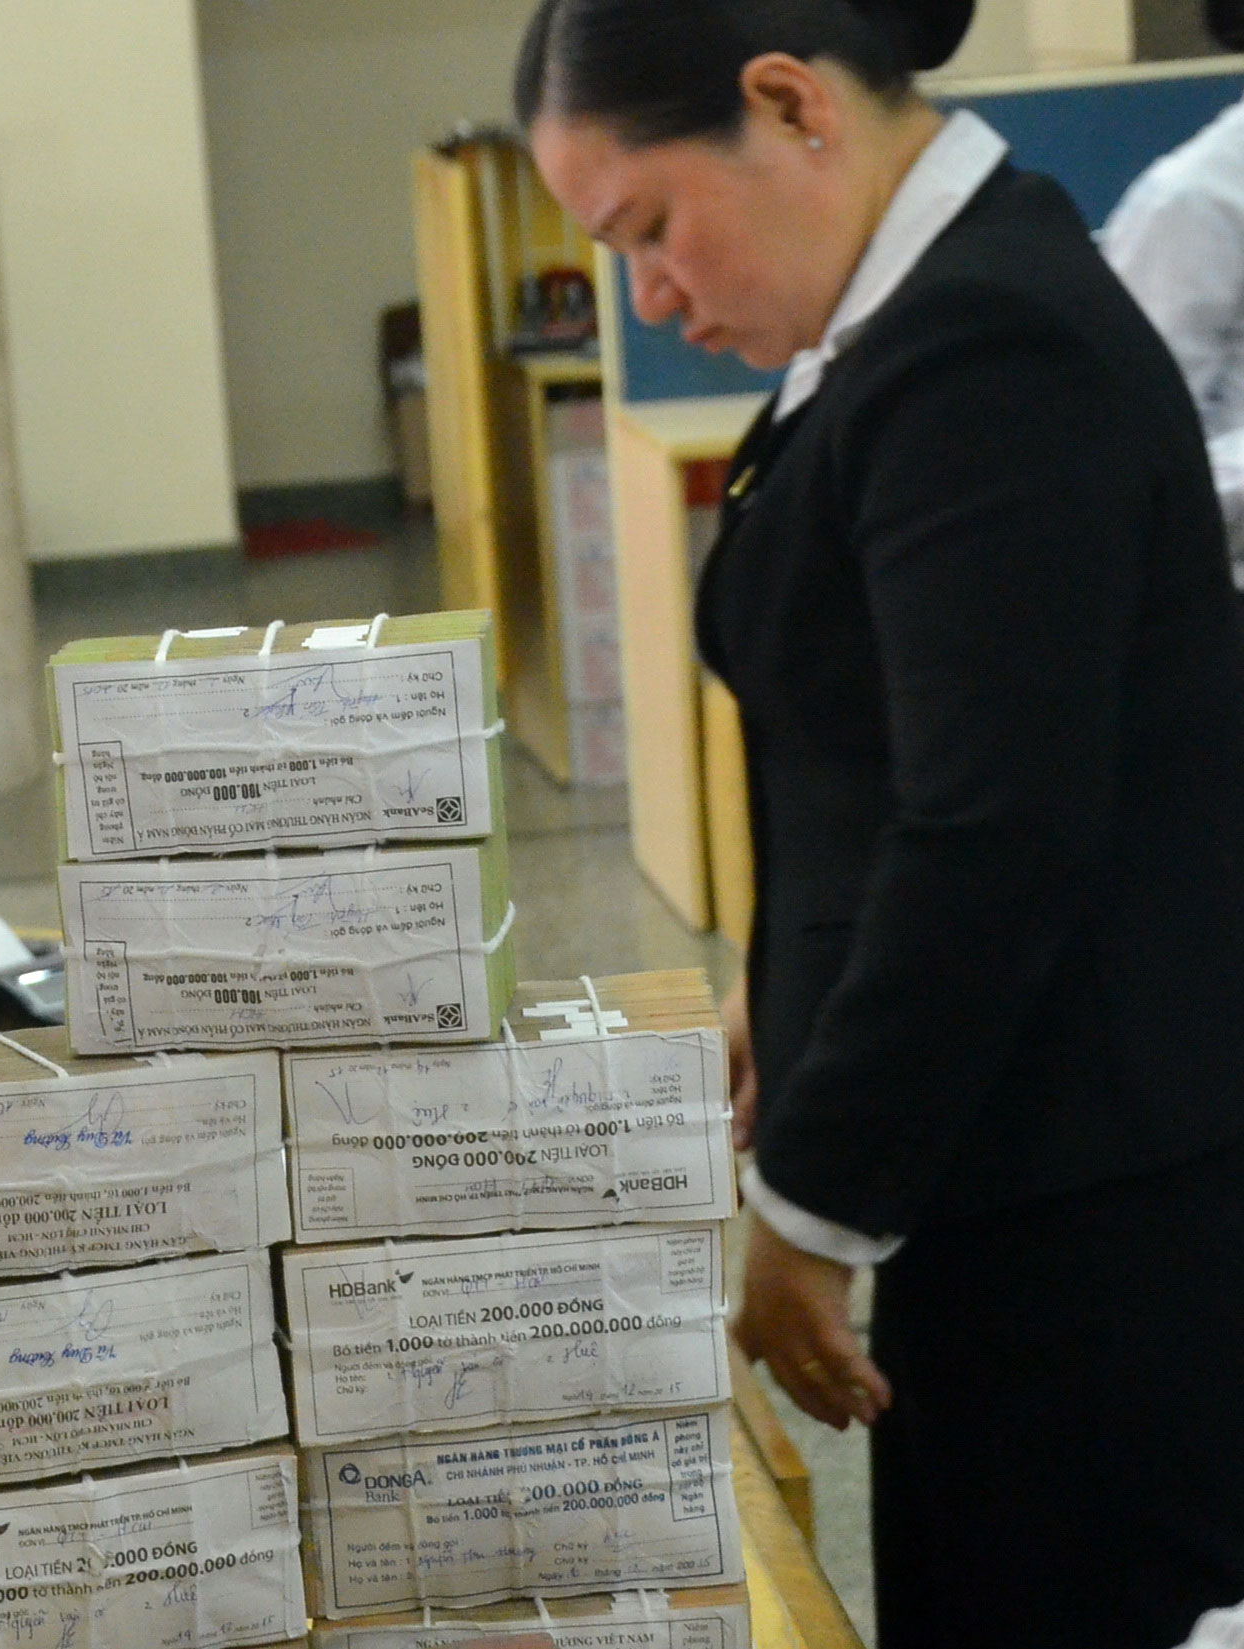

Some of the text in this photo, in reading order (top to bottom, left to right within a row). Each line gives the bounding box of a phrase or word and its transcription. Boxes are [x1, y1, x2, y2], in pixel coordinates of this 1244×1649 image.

[289, 760, 317, 772] 1.000
[165, 768, 227, 783] 100.000.000
[213, 783, 261, 801] 100.000
[344, 794, 362, 804] Chi
[382, 806, 434, 817] SeABank
[147, 829, 169, 838] NAM
[166, 973, 227, 985] 100.000.000
[290, 970, 317, 980] 1.000
[214, 989, 261, 1004] 100.000
[345, 1002, 362, 1011] Chi
[383, 1013, 435, 1024] SeABank
[147, 1028, 170, 1037] NAM
[584, 1119, 630, 1137] 1.000
[373, 1131, 488, 1149] 200.000.000
[464, 1149, 537, 1167] 200.000
[619, 1174, 687, 1193] HDBank
[24, 1209, 77, 1224] 200.000
[88, 1241, 121, 1252] TMCP
[329, 1280, 396, 1298] HDBank
[480, 1302, 553, 1322] 200.000
[388, 1336, 434, 1353] 1.000
[530, 1316, 642, 1339] 200.000.000
[28, 1409, 80, 1427] 200.000
[629, 1450, 655, 1461] MINH
[366, 1489, 399, 1503] Bank
[171, 1505, 192, 1515] MINH
[463, 1494, 639, 1520] 1.000 200.000.000
[125, 1554, 236, 1585] 200.000.000
